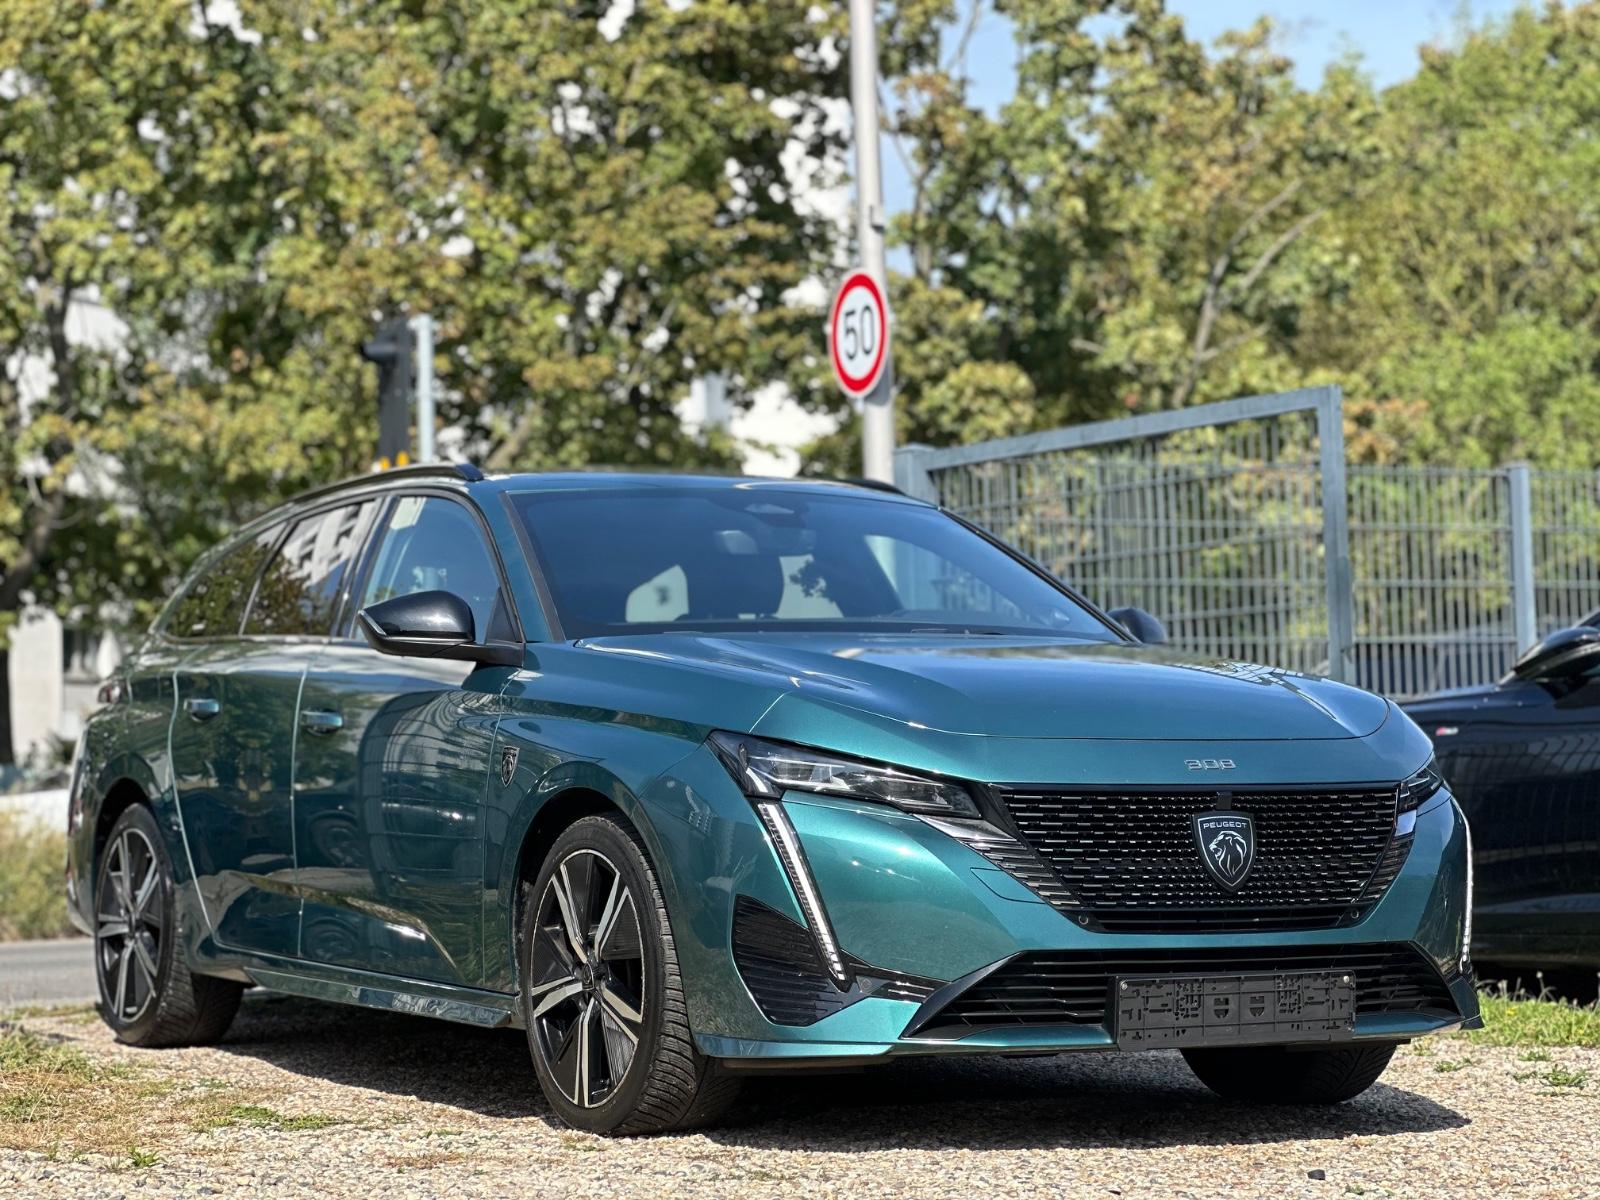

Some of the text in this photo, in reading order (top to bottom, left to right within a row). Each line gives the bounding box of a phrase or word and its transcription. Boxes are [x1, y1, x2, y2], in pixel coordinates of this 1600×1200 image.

[845, 305, 874, 360] 50
[1184, 759, 1236, 770] 308
[1203, 821, 1247, 829] PEUGEOT
